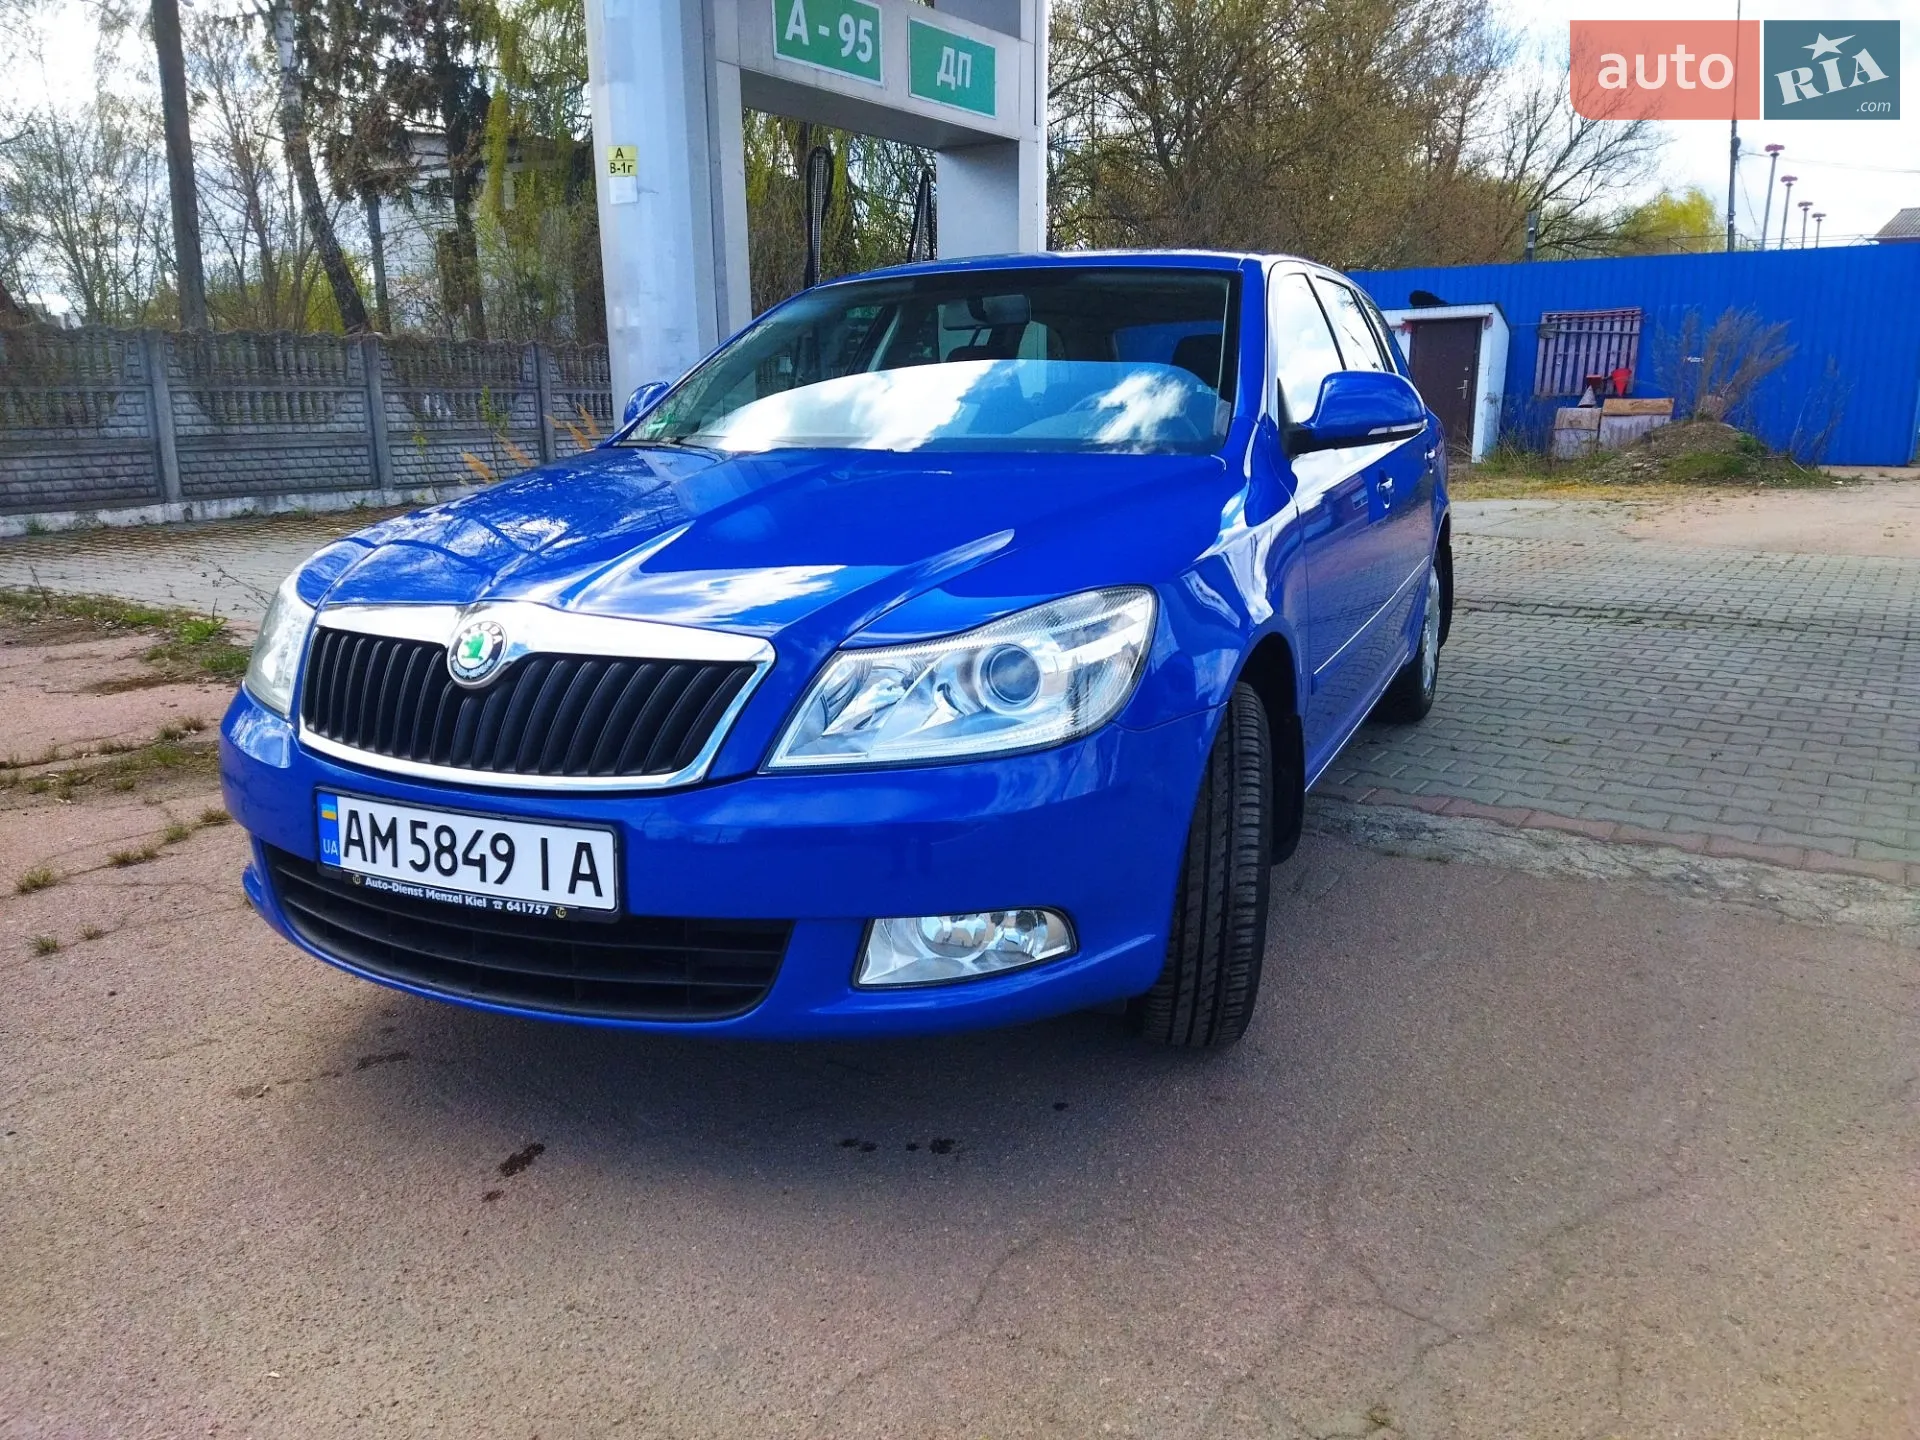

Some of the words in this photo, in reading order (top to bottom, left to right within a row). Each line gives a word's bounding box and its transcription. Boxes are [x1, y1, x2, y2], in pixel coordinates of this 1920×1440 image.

[937, 45, 972, 90] ДП
[615, 147, 624, 158] А
[323, 838, 338, 856] UA
[365, 877, 424, 897] Auto-Dienst
[425, 889, 462, 904] Menzel
[465, 895, 487, 907] Kiel
[506, 901, 549, 915] 641757
